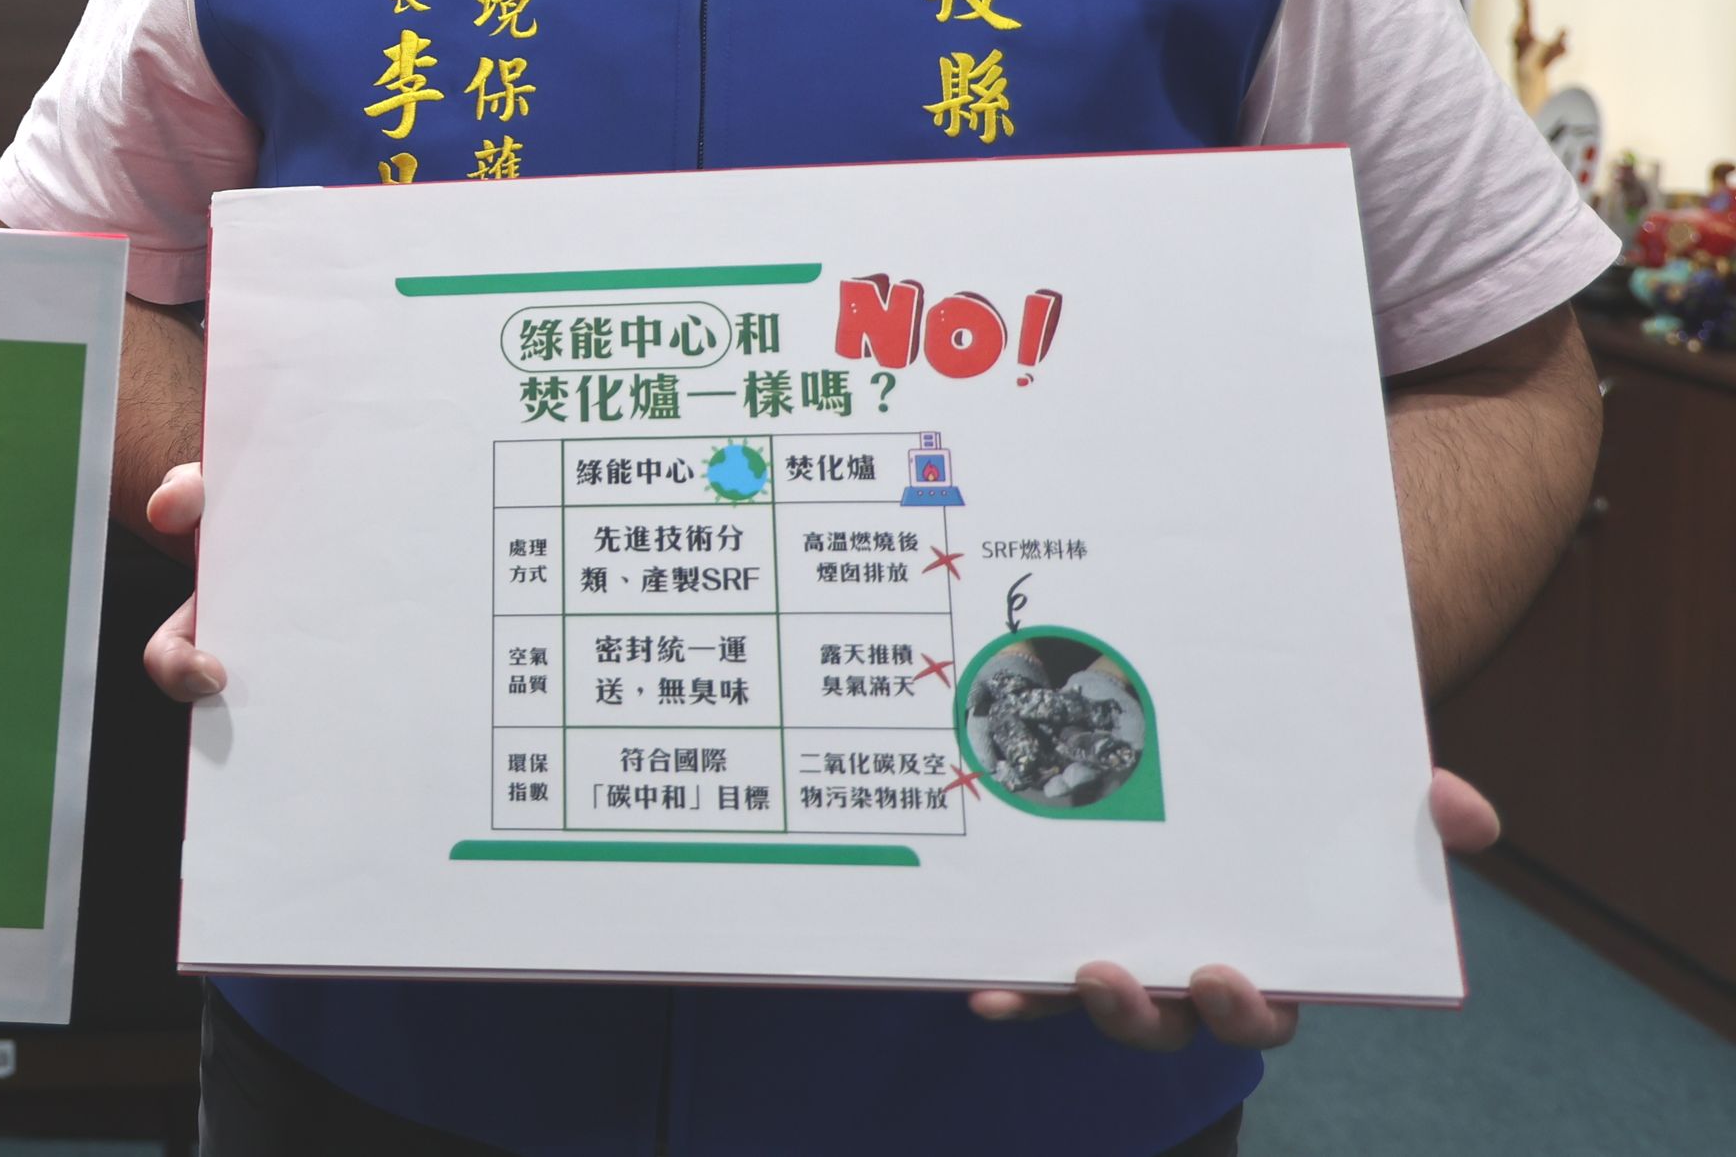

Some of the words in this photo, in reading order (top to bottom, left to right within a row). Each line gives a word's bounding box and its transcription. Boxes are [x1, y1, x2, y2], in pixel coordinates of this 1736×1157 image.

[834, 272, 1064, 388] NO!
[518, 369, 898, 425] 焚化爐一樣嗎？
[575, 457, 696, 487] 綠能中心
[785, 453, 878, 483] 焚化爐
[508, 538, 548, 558] 處理
[593, 524, 744, 553] 先進技術分
[802, 530, 920, 553] 高溫燃燒後
[981, 538, 1089, 561] SRF燃料棒
[509, 564, 548, 584] 方式
[580, 566, 761, 594] 類、產製SRF
[816, 561, 910, 584] 煙囪排放
[508, 646, 549, 667] 空氣
[594, 634, 748, 664] 密封統一運
[508, 674, 548, 695] 品質
[595, 676, 750, 706] 送，無臭味
[821, 675, 916, 697] 臭氣滿天
[507, 753, 549, 774] 環保
[619, 746, 728, 774] 符合國際
[799, 751, 947, 776] 二氧化碳及空
[507, 781, 549, 803] 指數
[592, 783, 772, 812] 「碳中和」目標
[800, 785, 950, 811] 物污染物排放
